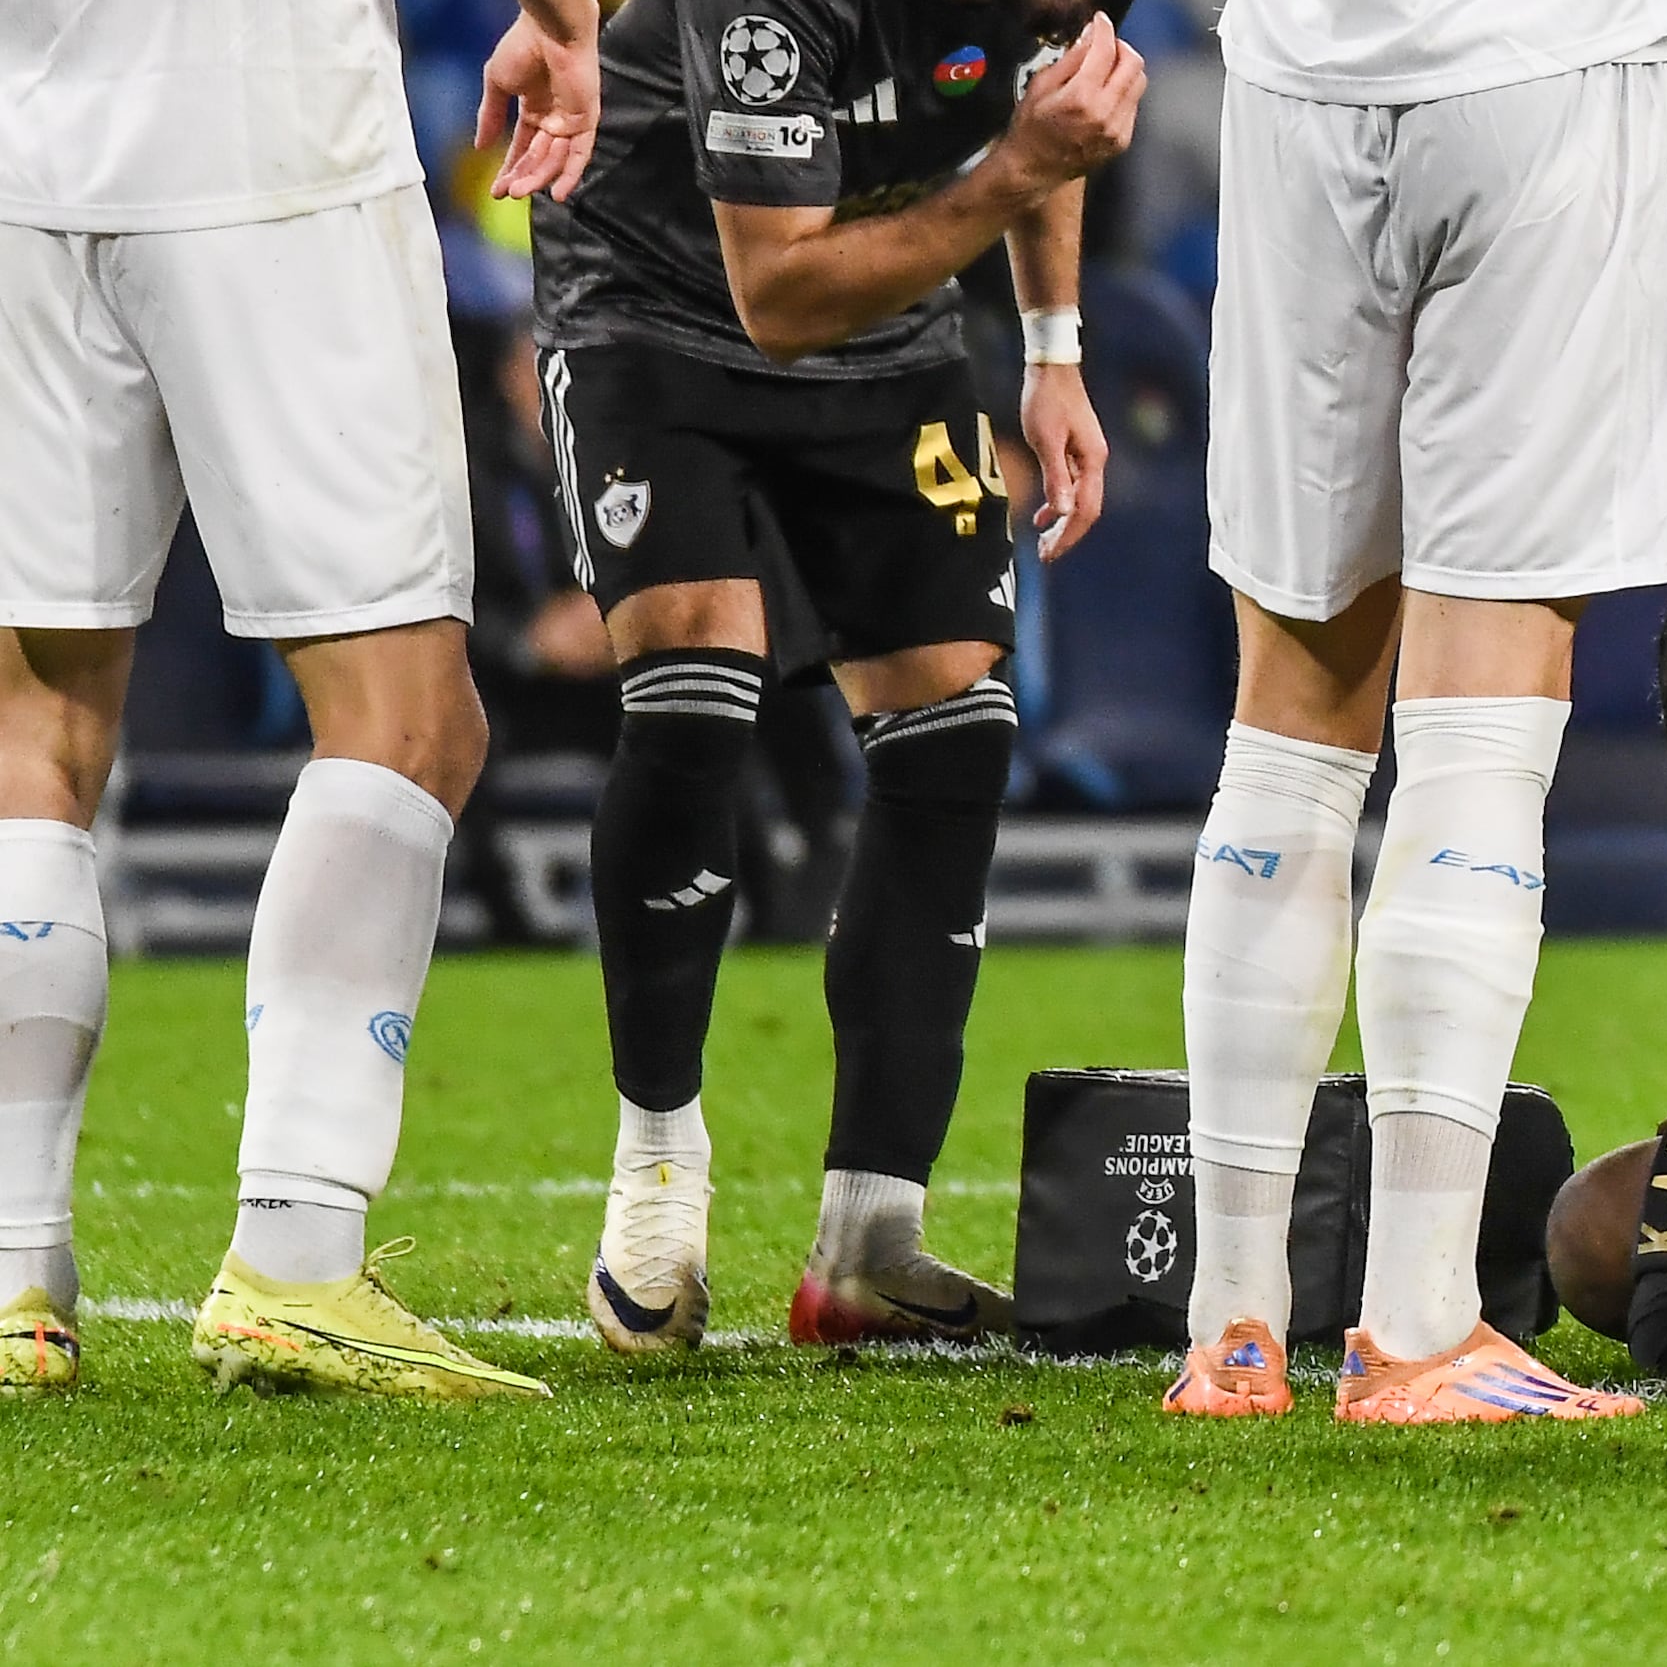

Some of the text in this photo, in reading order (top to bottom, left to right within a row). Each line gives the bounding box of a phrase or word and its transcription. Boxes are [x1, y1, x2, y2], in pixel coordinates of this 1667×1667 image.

[1199, 836, 1280, 880] EA7
[1123, 1134, 1191, 1154] EAGUE
[1139, 1181, 1174, 1200] UEFA
